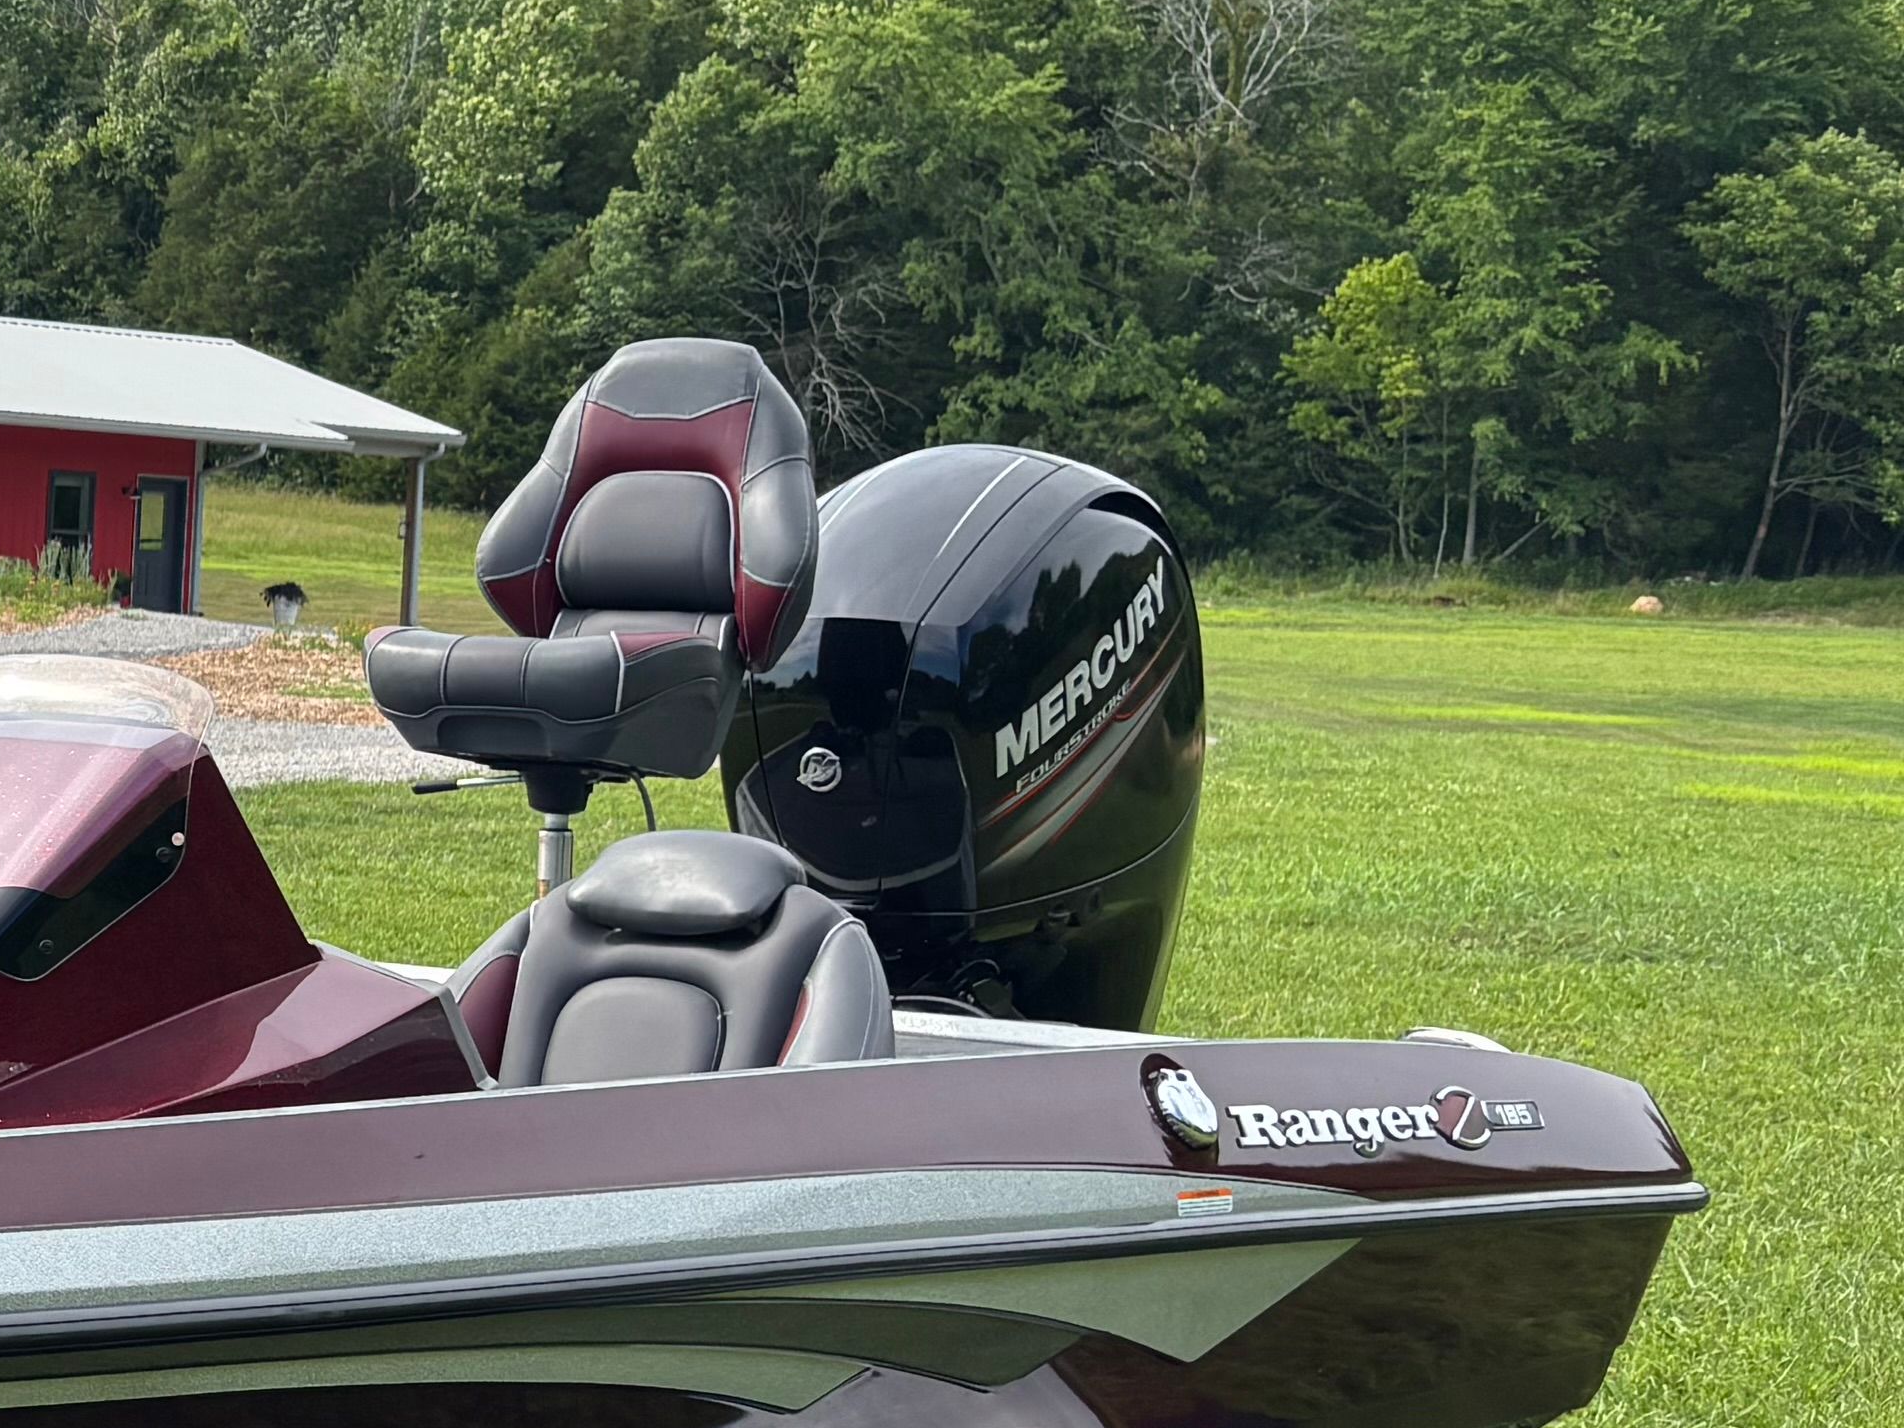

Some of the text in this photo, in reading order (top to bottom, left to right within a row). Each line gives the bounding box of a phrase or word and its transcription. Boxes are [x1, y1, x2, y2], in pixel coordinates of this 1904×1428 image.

[995, 555, 1165, 779] MERCURY
[1015, 678, 1131, 794] FOURSTROKE
[1226, 1104, 1440, 1158] Ranger
[1495, 1103, 1533, 1126] 185
